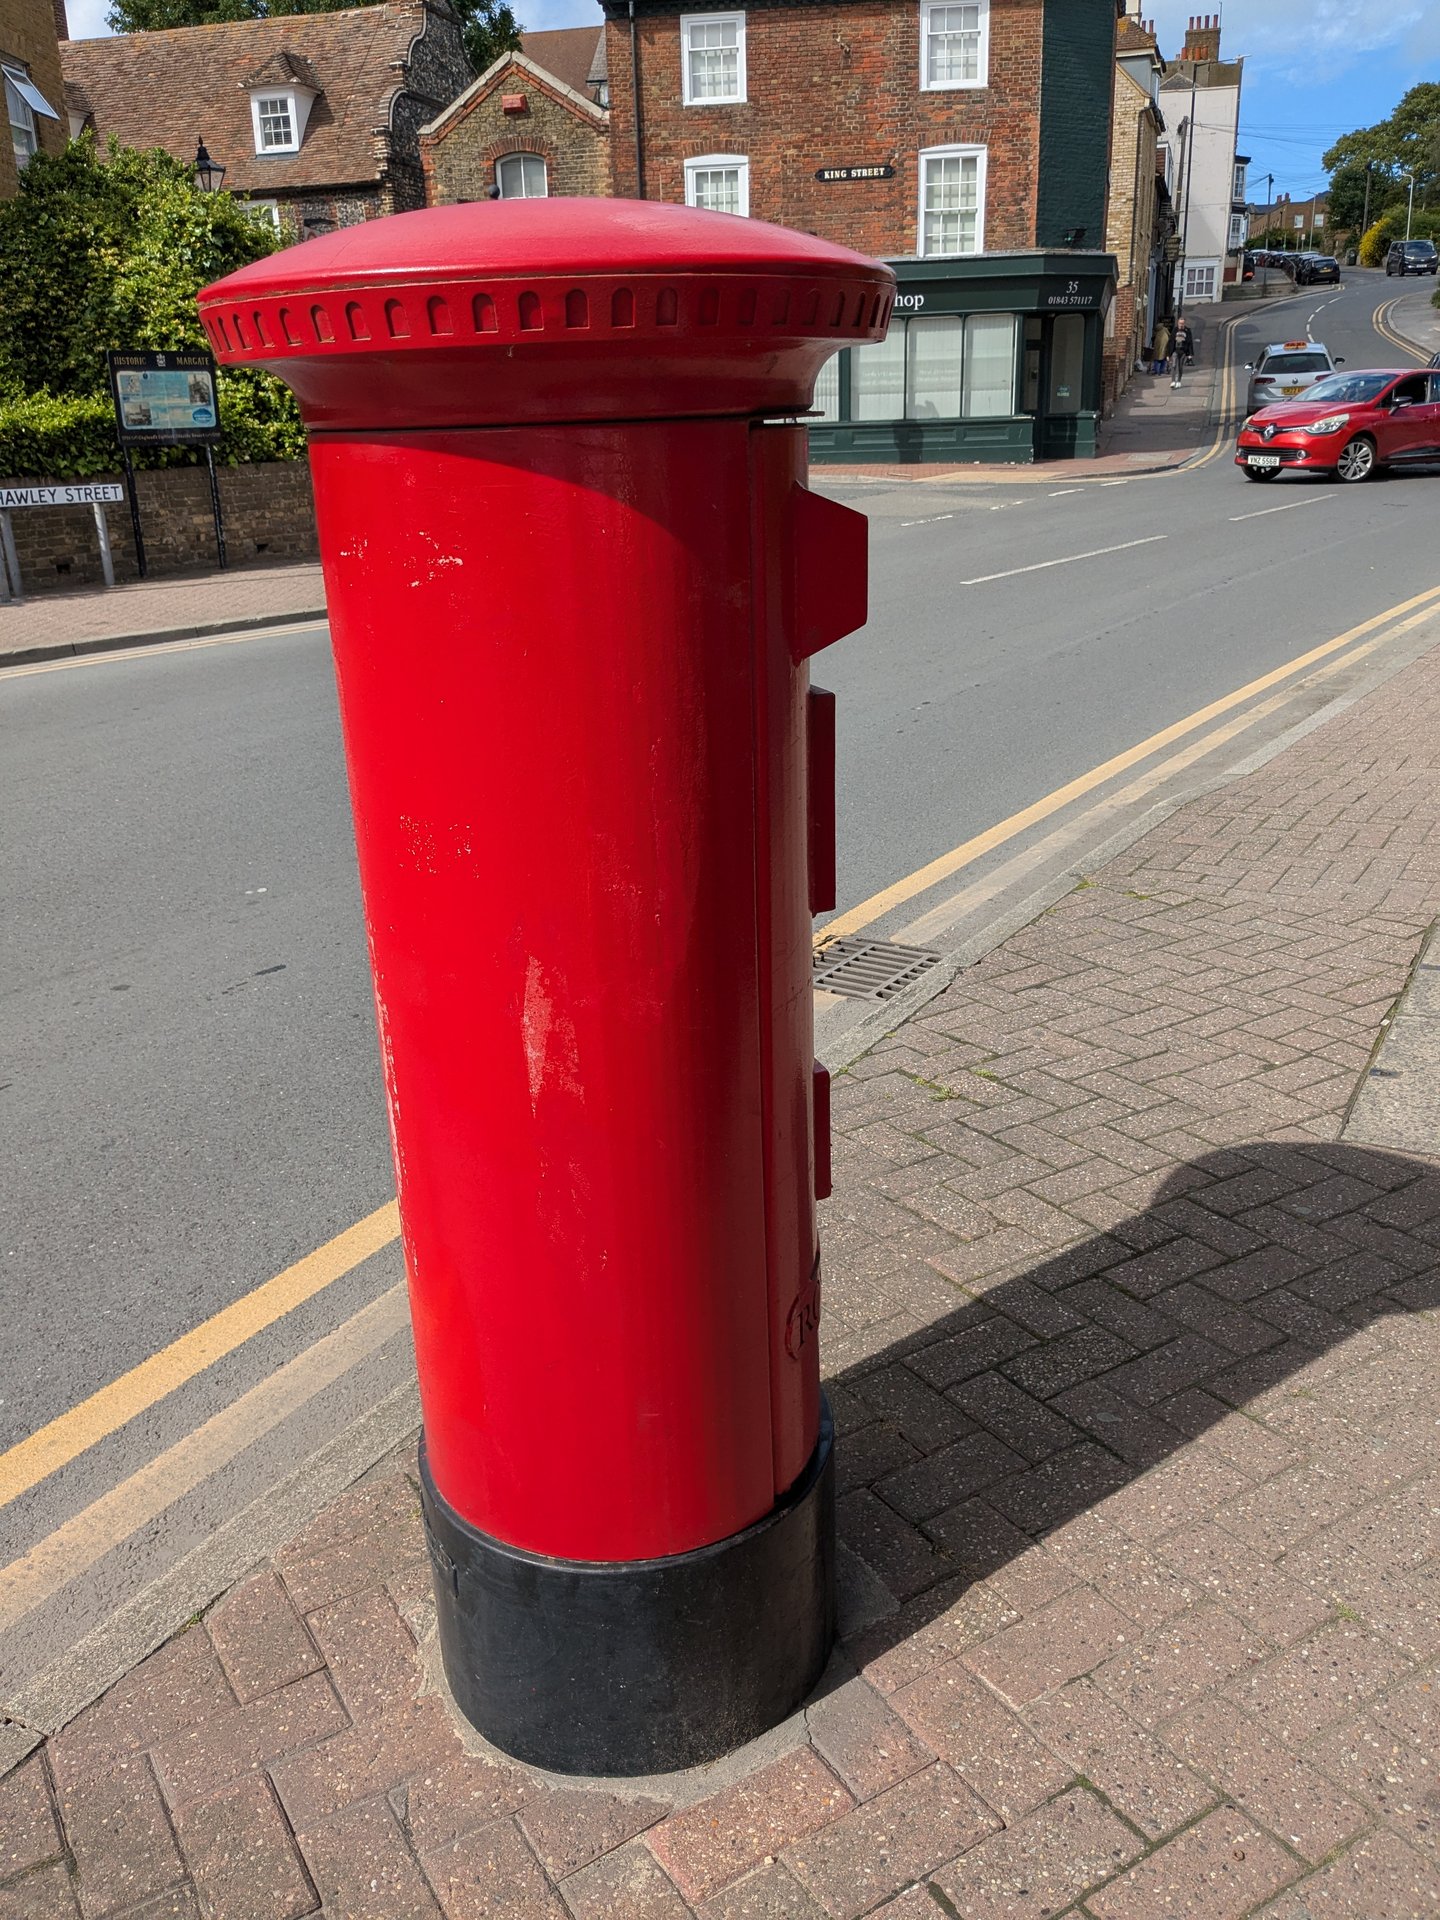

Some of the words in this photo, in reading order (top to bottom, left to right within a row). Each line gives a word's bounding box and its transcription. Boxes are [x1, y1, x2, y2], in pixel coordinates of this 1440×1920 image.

[823, 170, 847, 179] KING
[851, 167, 885, 178] STREET
[1066, 281, 1079, 293] 35
[894, 292, 924, 310] hop
[1047, 295, 1068, 304] 01843
[1069, 295, 1092, 304] 571117
[114, 356, 146, 366] HISTORIC
[176, 356, 209, 366] MARGATE
[65, 486, 120, 503] STREET
